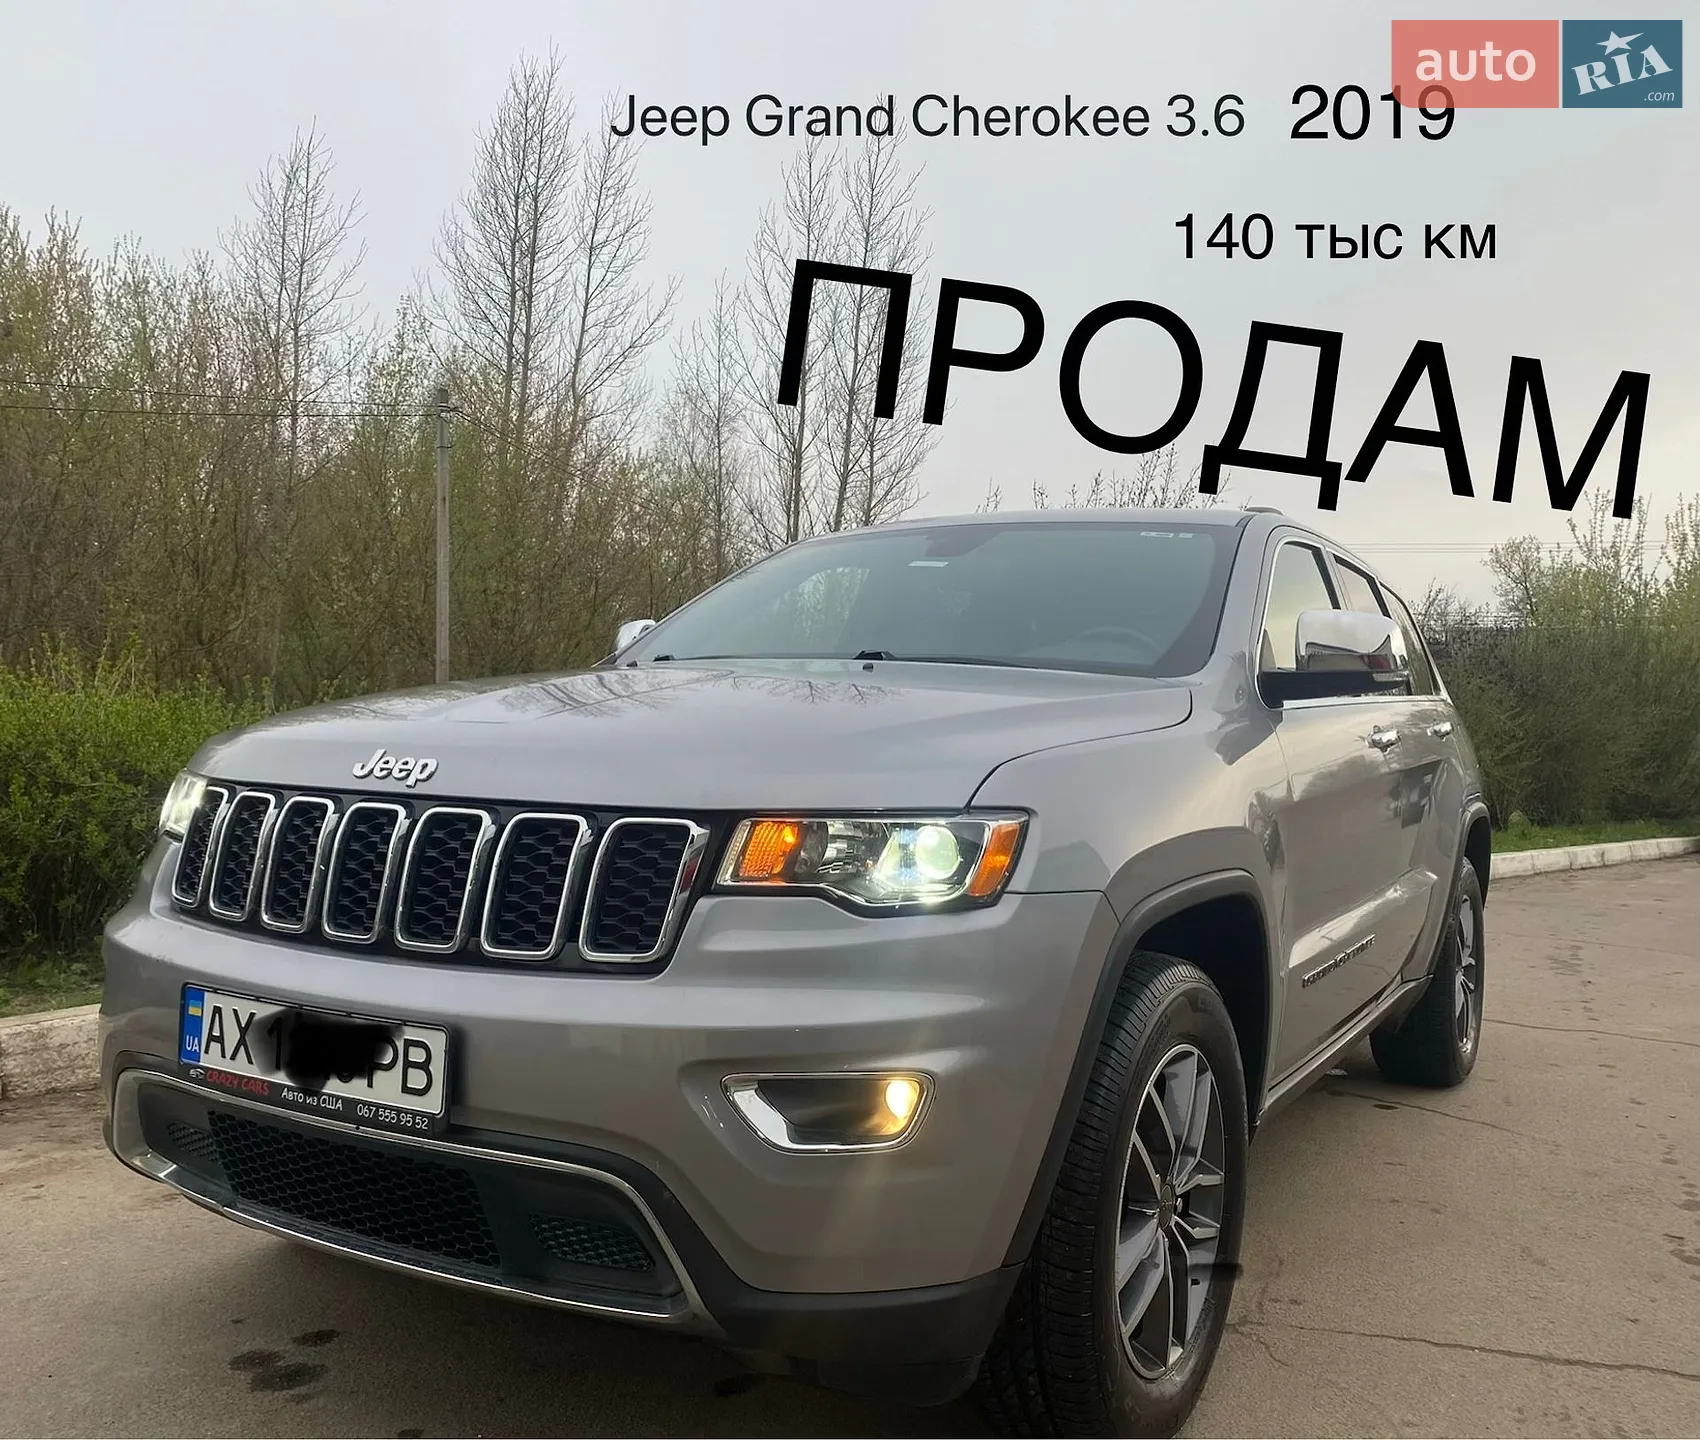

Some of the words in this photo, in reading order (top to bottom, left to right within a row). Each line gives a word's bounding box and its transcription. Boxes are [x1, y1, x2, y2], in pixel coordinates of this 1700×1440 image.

[352, 749, 438, 788] Jeep
[186, 1036, 200, 1053] UA
[206, 1069, 239, 1089] CRAZY
[241, 1078, 271, 1097] CARS
[281, 1087, 304, 1103] Авто
[306, 1095, 318, 1106] из
[319, 1095, 344, 1111] США
[356, 1103, 375, 1118] 067
[378, 1108, 398, 1123] 555
[400, 1113, 413, 1128] 95
[415, 1118, 429, 1130] 52
